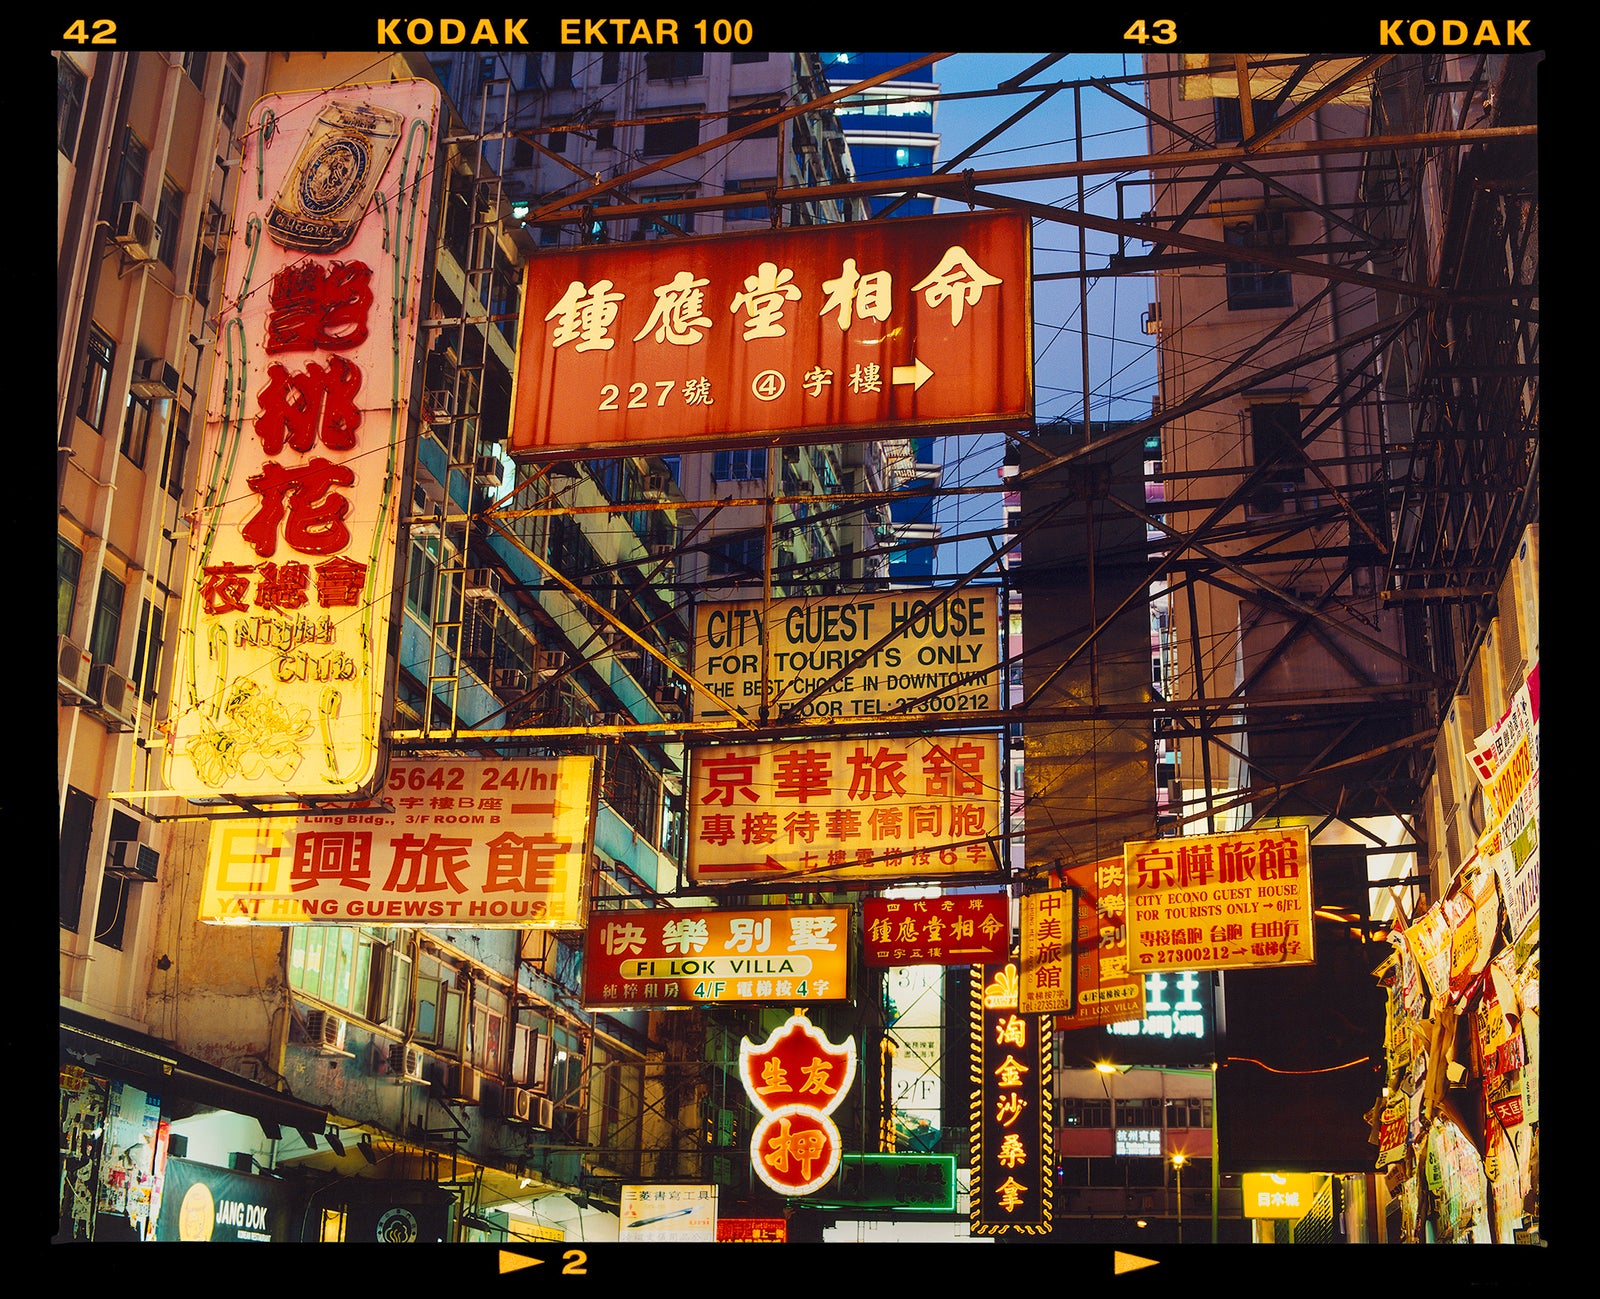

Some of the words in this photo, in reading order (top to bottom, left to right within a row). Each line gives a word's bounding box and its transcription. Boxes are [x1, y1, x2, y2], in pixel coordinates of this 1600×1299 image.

[544, 245, 1003, 353] 鍾應堂相命
[707, 609, 764, 649] CITY
[785, 603, 875, 644] GUEST
[891, 598, 985, 639] HOUSE
[708, 654, 758, 675] FOR
[774, 647, 901, 672] TOURISTS
[917, 644, 983, 666] ONLY
[704, 682, 734, 697] THE
[743, 680, 784, 696] BEST
[793, 676, 854, 694] CHOICE
[863, 675, 879, 691] IN
[887, 671, 988, 690] DOWNTOWN
[304, 815, 344, 826] Lung
[405, 815, 430, 825] 3/F
[434, 815, 486, 824] ROOM
[490, 815, 501, 824] B
[217, 898, 261, 915] YAT
[271, 898, 338, 915] HING
[346, 899, 463, 917] GUEWST
[469, 899, 566, 917] HOUSE
[1135, 893, 1163, 907] CITY
[1168, 891, 1208, 905] ECONO
[1213, 888, 1252, 902] GUEST
[1258, 884, 1298, 898] HOUSE
[1136, 910, 1160, 921] FOR
[1165, 904, 1222, 919] TOURISTS
[1227, 901, 1259, 914] ONLY
[1276, 899, 1302, 913] 6/FL
[601, 916, 838, 955] 快樂別墅
[1250, 919, 1300, 938] 自由行
[1036, 894, 1062, 989] 中美旅館
[1157, 946, 1230, 963] 27300212
[636, 961, 655, 976] FI
[670, 961, 716, 976] LOK
[730, 959, 795, 974] VILLA
[693, 981, 726, 998] 4/F
[1113, 1001, 1139, 1012] VILLA
[897, 1078, 935, 1103] 2/F
[764, 1117, 827, 1181] 押
[216, 1199, 245, 1227] JANG
[245, 1204, 267, 1230] DOK
